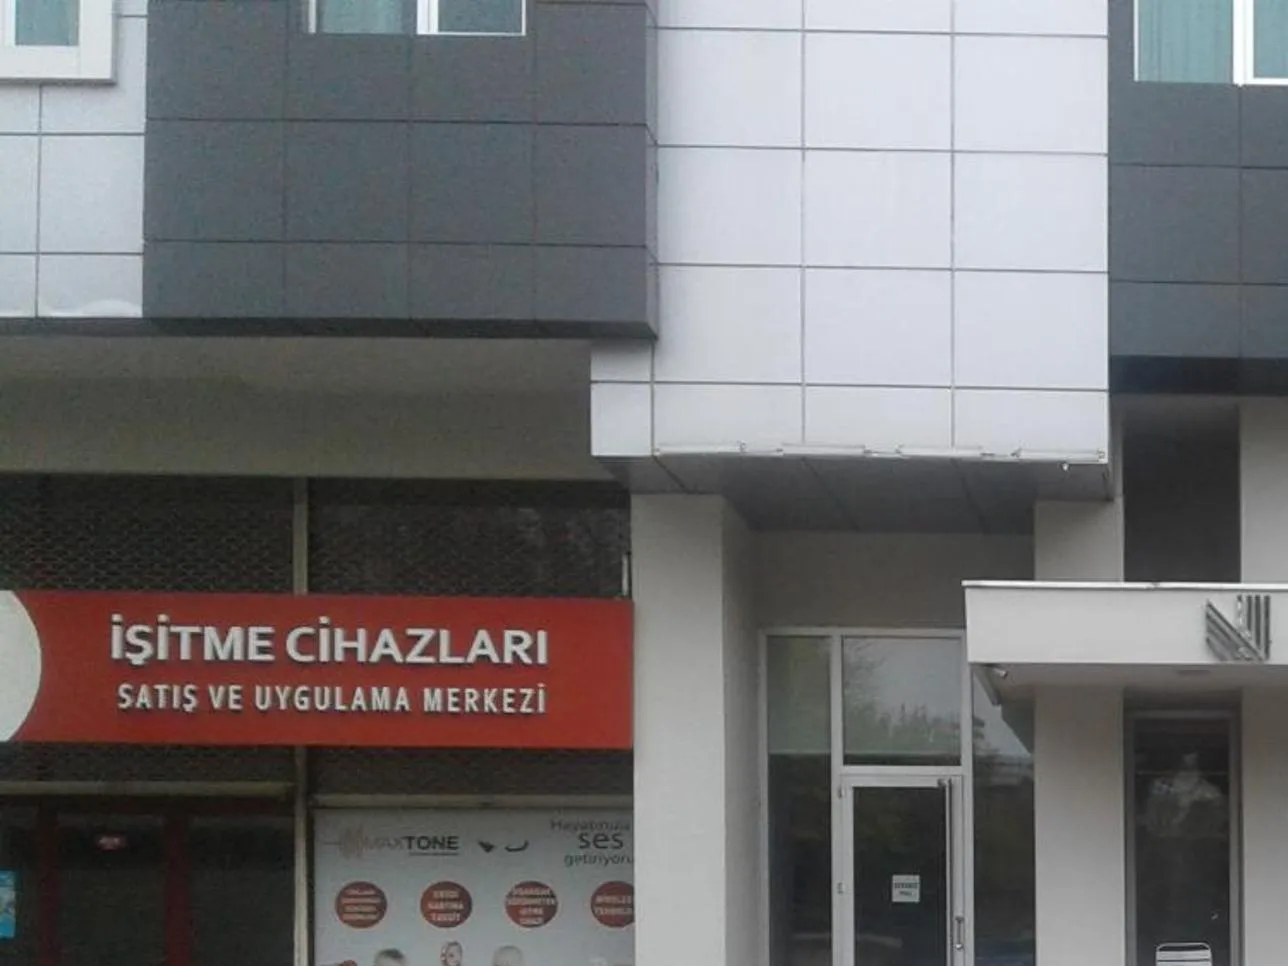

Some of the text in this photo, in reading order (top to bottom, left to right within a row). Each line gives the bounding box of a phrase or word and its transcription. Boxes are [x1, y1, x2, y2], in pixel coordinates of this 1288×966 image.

[111, 614, 548, 665] İŞİTME CİHAZLARI
[117, 683, 547, 714] SATIŞ VE UYGULAMA MERKEZİ
[578, 833, 624, 849] ses
